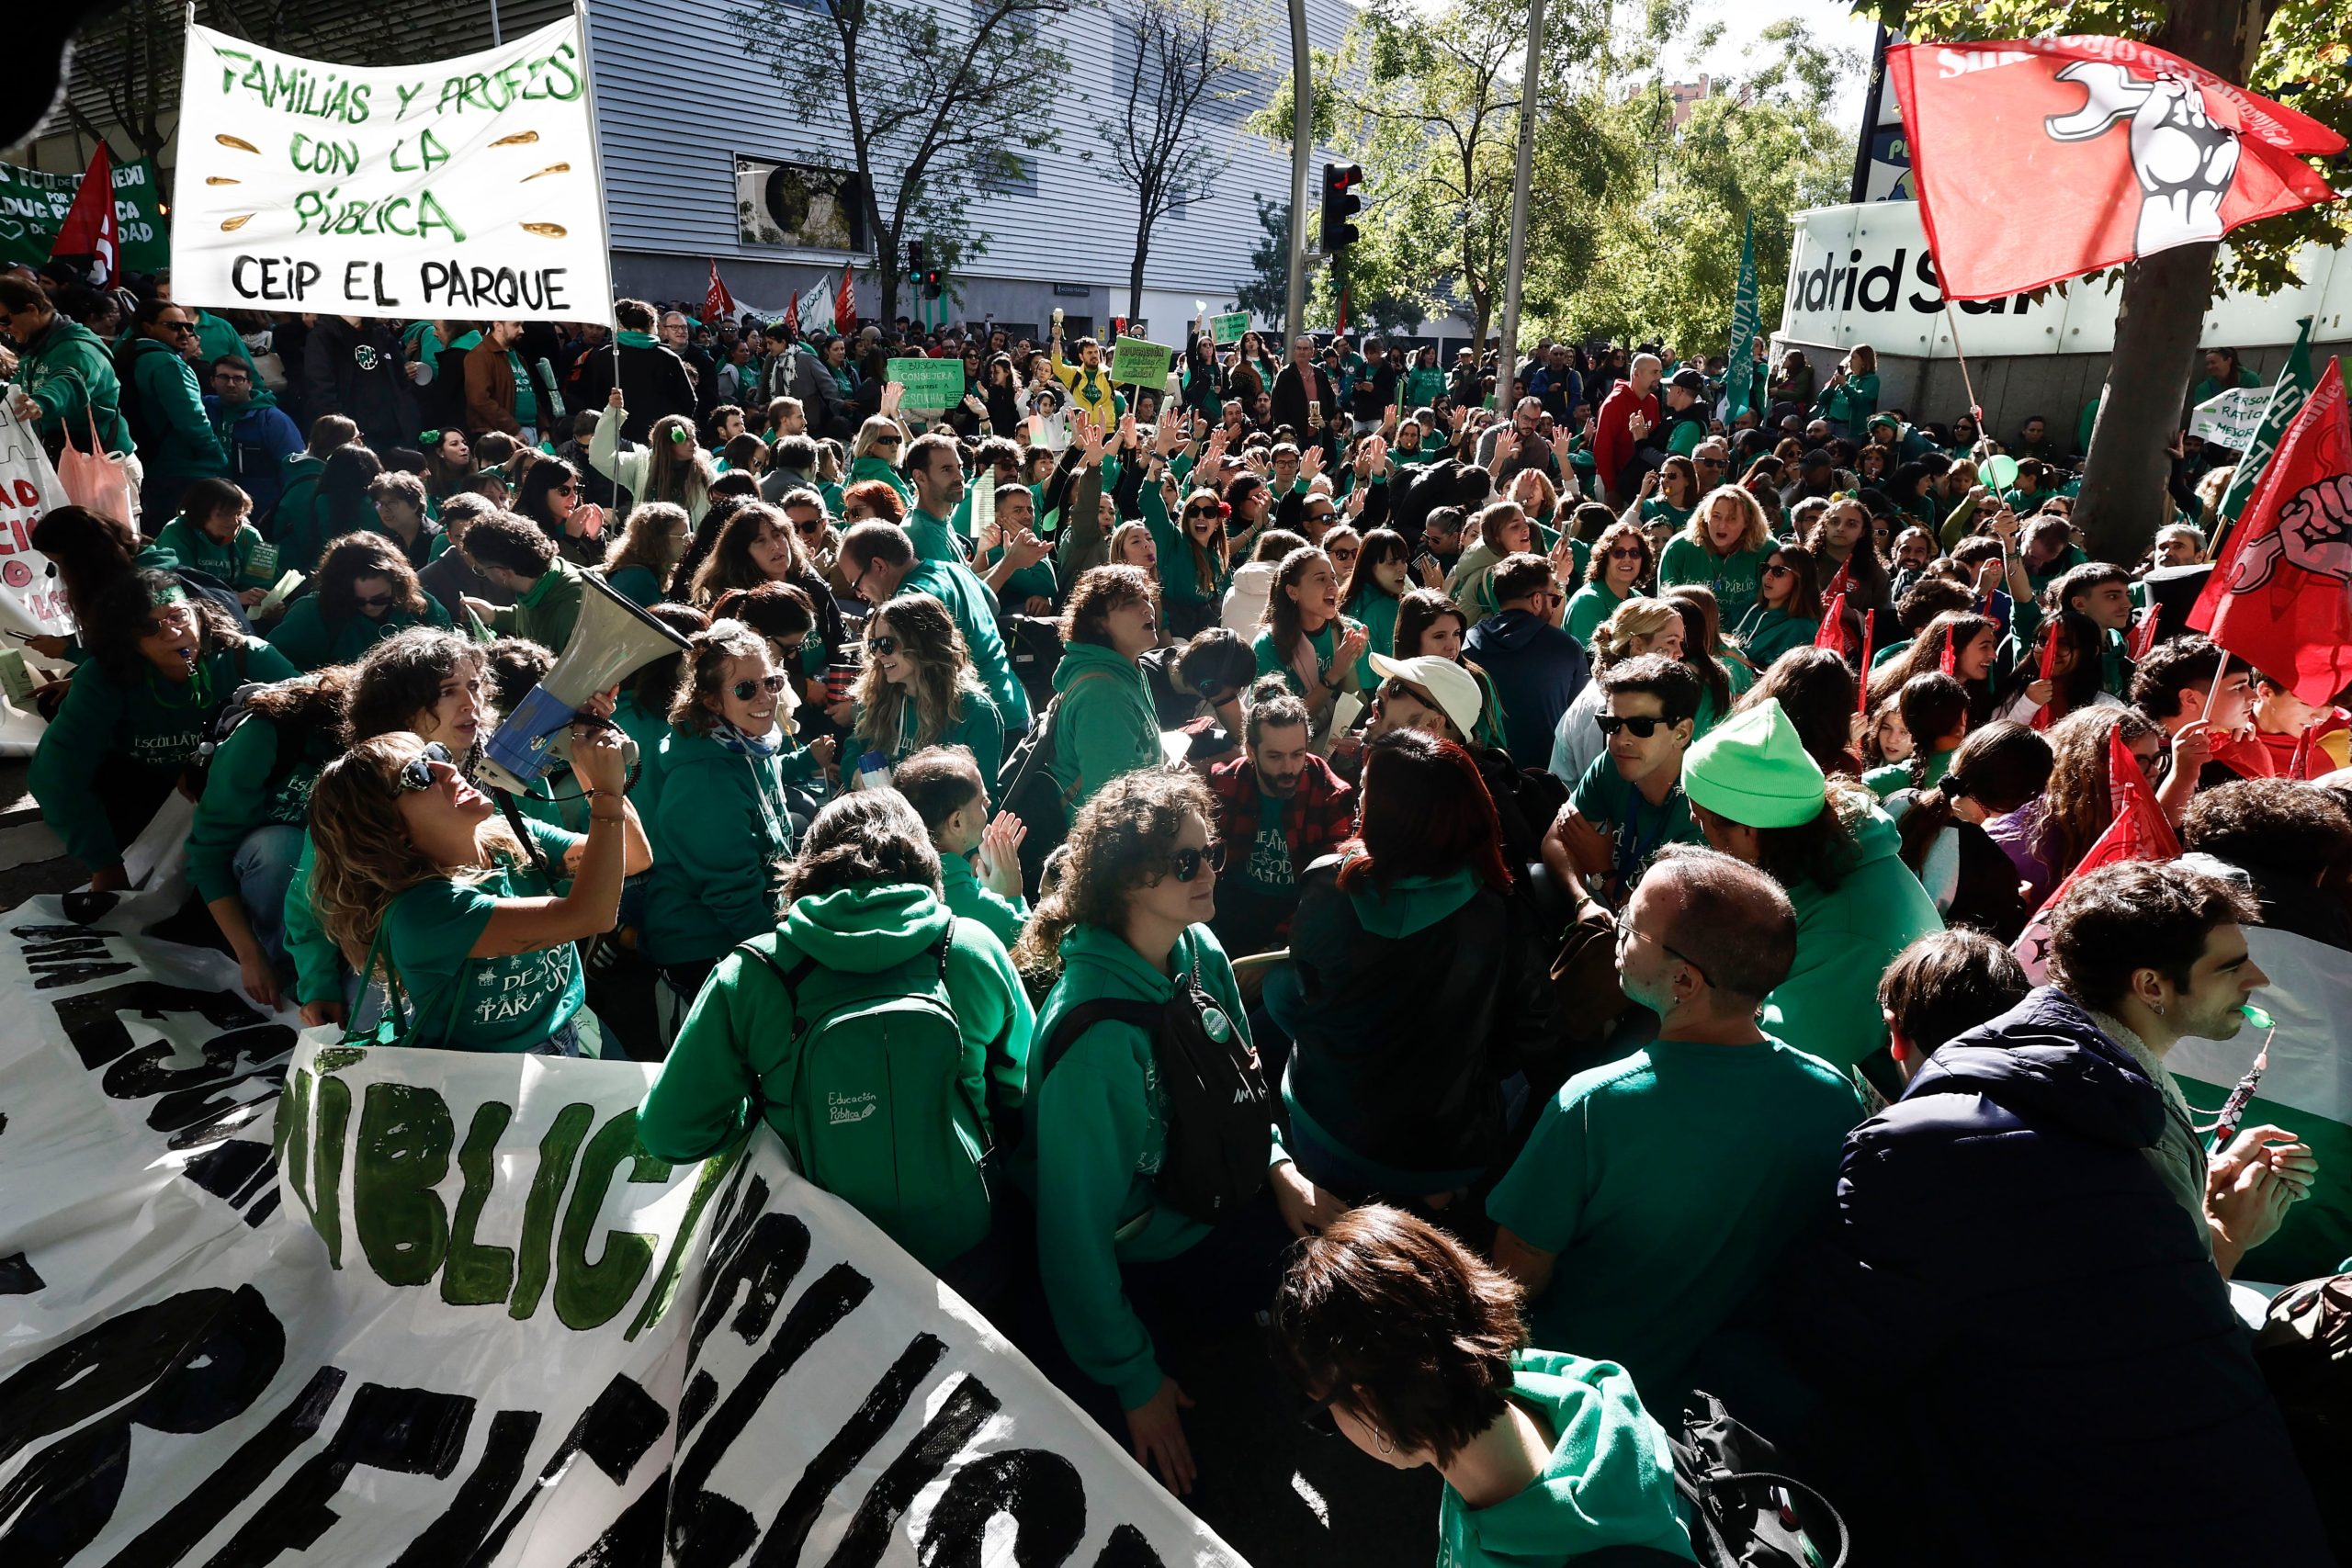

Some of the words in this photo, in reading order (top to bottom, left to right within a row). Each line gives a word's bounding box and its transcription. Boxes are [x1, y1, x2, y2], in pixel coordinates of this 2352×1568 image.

[395, 81, 424, 120] Y
[435, 41, 584, 114] PROFES
[289, 131, 359, 176] CON
[390, 128, 450, 173] LA
[345, 260, 401, 307] EL
[421, 259, 571, 310] PARQUE
[909, 362, 937, 370] BUSCA
[503, 968, 537, 991] DE
[829, 1091, 876, 1105] Educación
[830, 1106, 860, 1121] Pública
[274, 1047, 749, 1343] ÚBLIC
